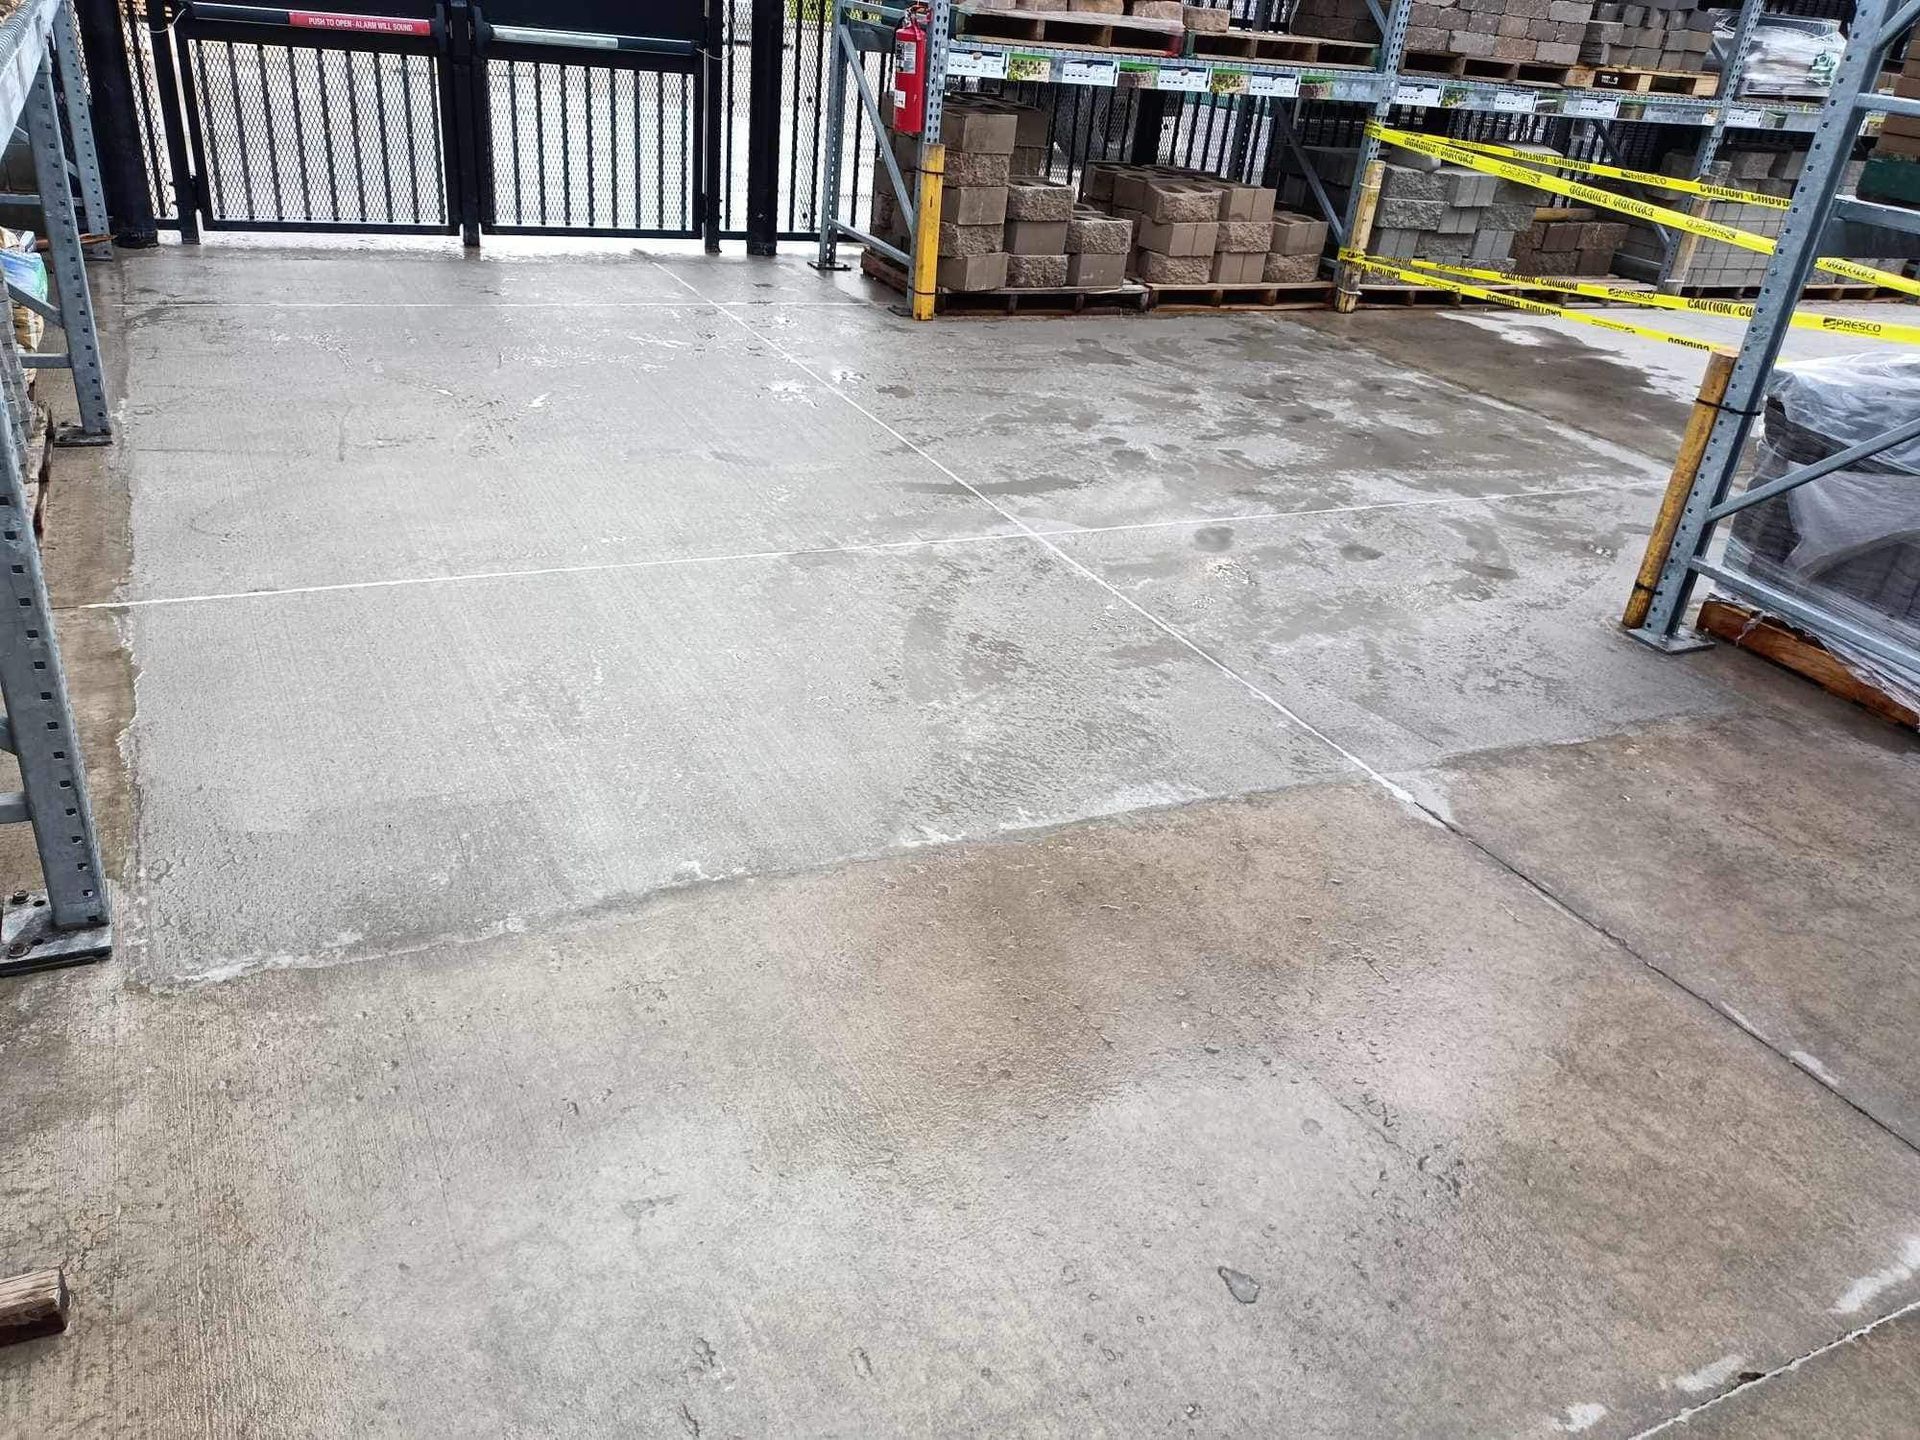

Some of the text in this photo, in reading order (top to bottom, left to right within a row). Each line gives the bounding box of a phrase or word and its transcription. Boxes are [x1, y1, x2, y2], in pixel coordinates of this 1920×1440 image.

[308, 17, 325, 26] PUSH
[326, 18, 334, 27] TO
[335, 19, 352, 28] OPEN
[355, 20, 377, 30] ALARM
[377, 22, 392, 31] WILL
[392, 23, 413, 32] SOUND
[1687, 298, 1732, 315] CAUTION
[1836, 319, 1881, 333] PRESCO
